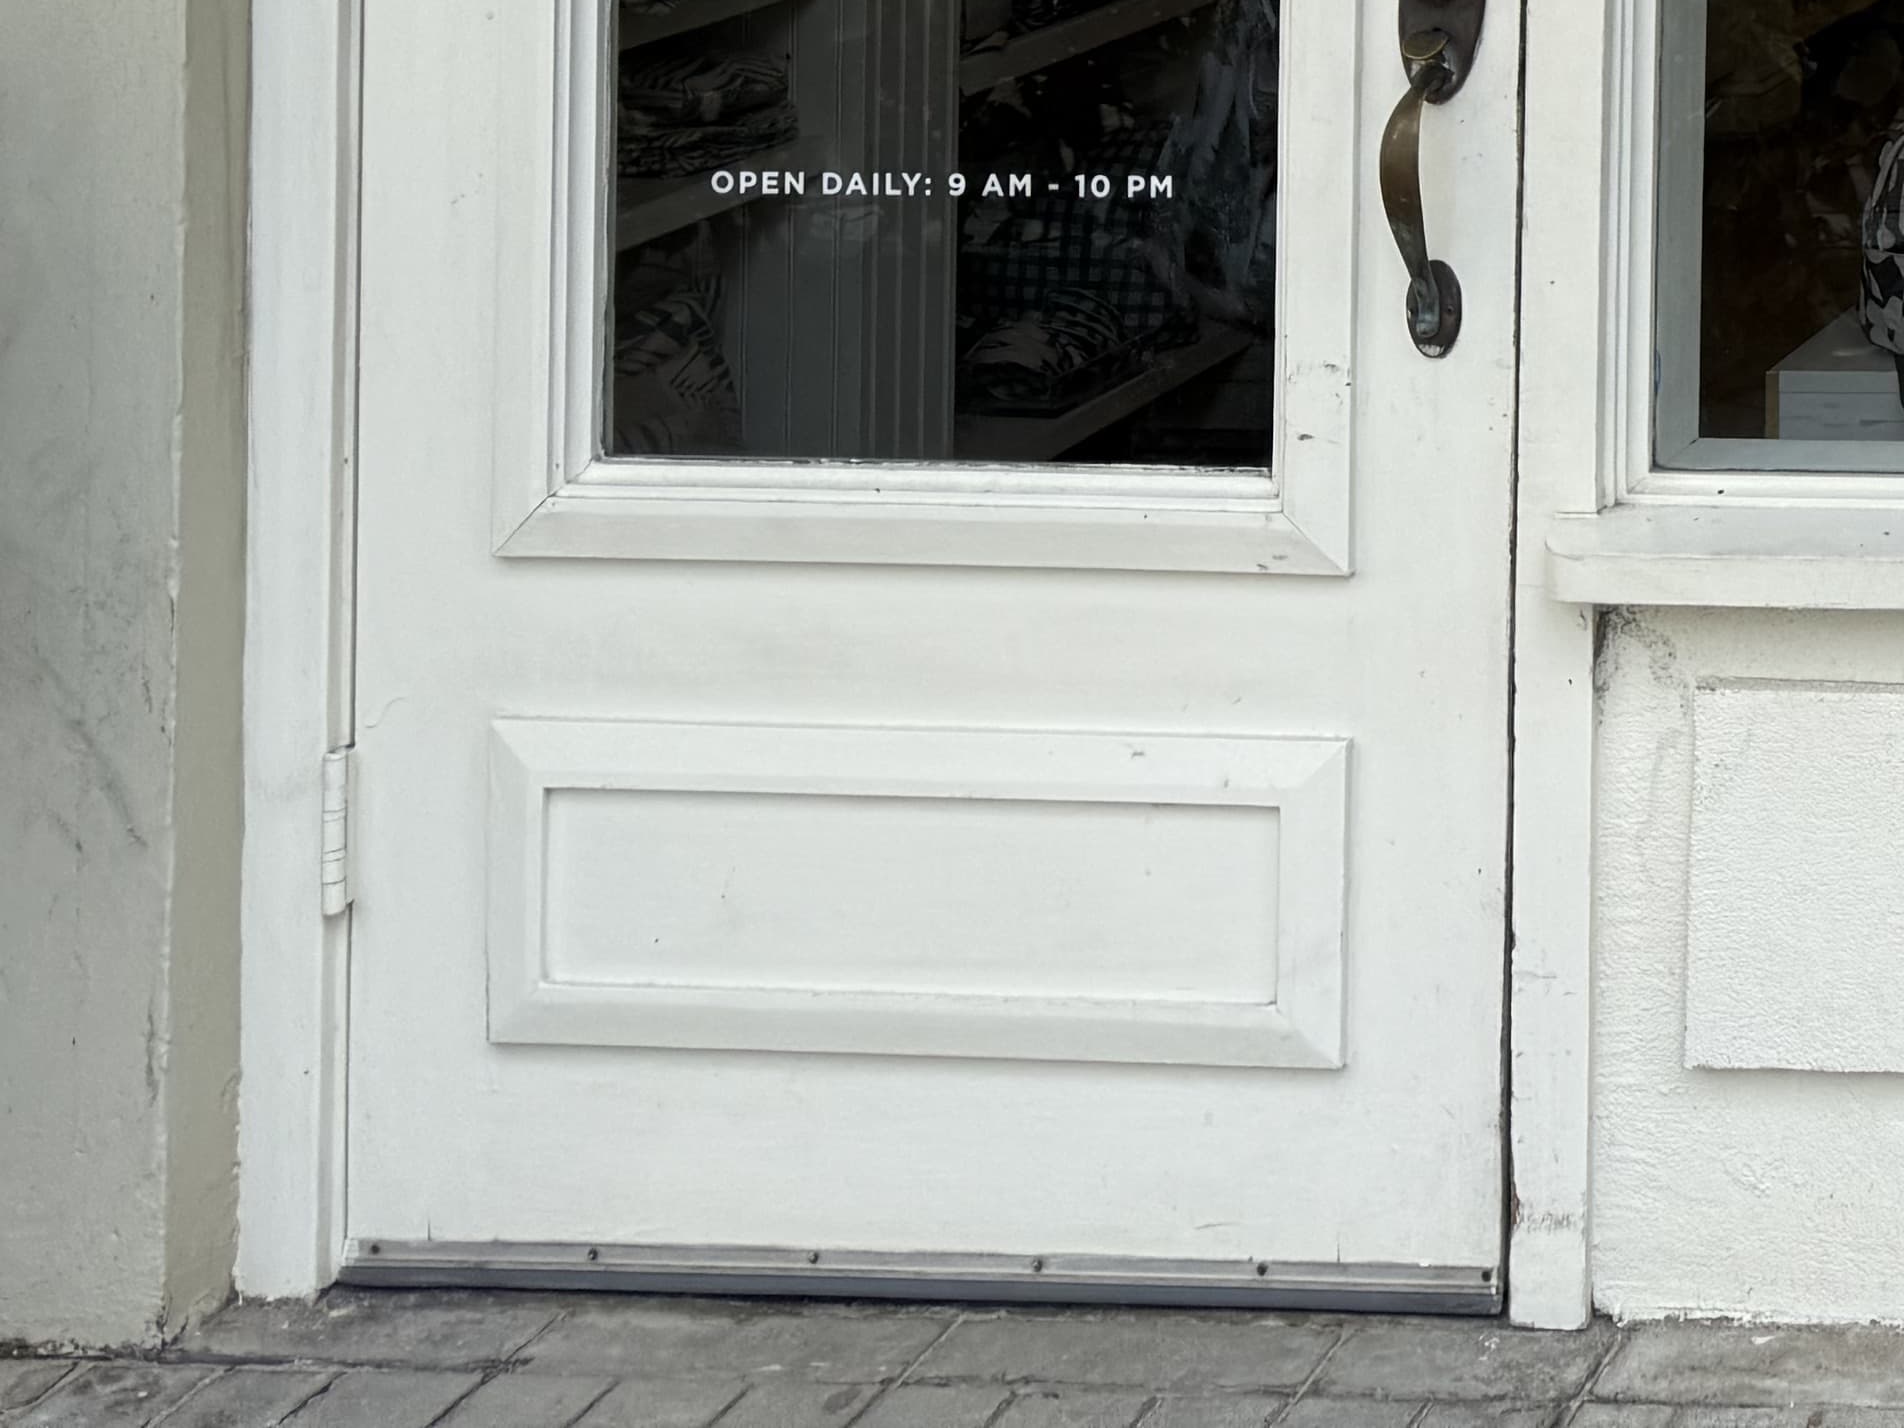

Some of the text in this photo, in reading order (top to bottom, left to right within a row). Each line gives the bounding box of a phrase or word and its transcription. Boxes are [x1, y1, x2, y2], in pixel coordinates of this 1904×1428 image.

[710, 170, 805, 195] OPEN
[822, 171, 932, 197] DAILY:
[948, 173, 966, 197] 9
[981, 173, 1032, 197] AM
[1074, 174, 1111, 198] 10
[1127, 174, 1174, 199] PM
